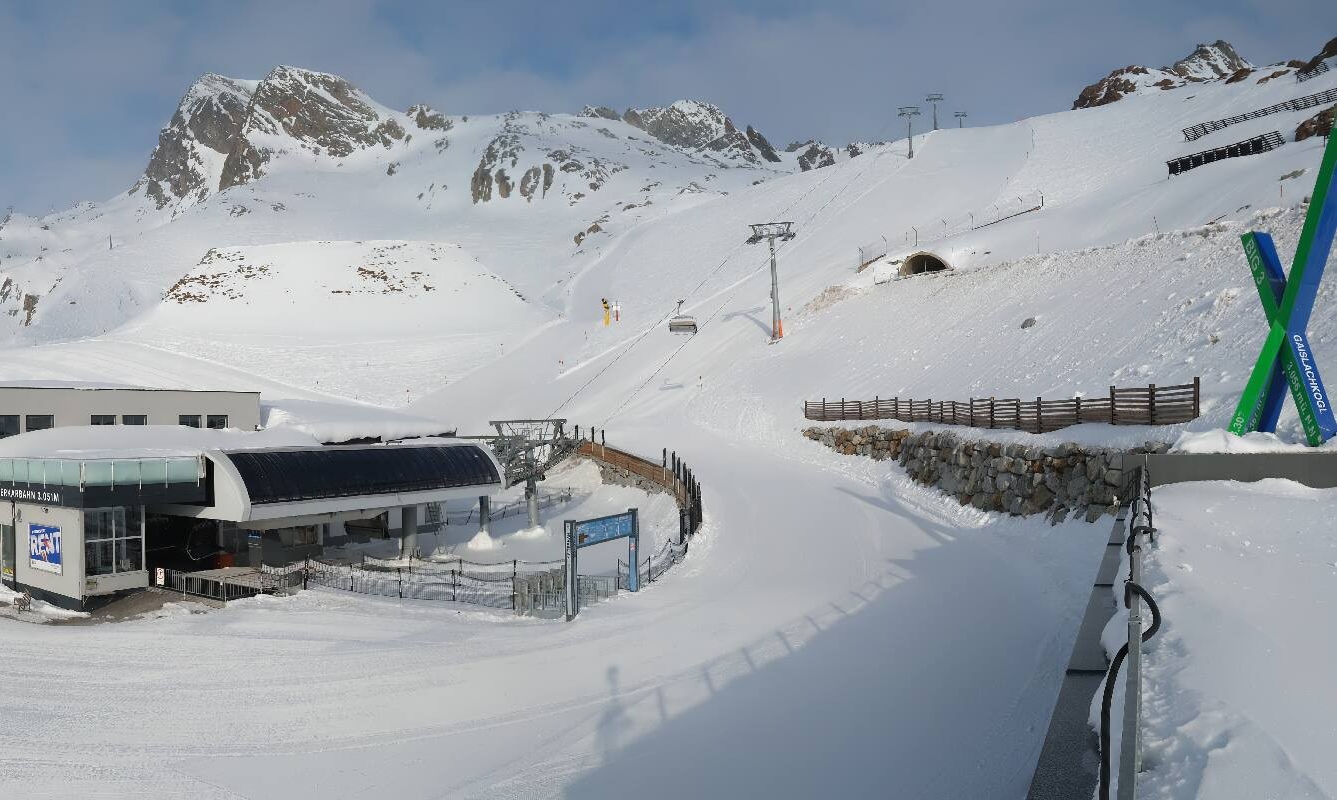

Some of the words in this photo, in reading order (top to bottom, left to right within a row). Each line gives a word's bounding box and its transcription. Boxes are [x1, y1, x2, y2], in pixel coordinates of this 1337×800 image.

[1246, 238, 1260, 271] BIG
[1257, 271, 1265, 285] 3
[1293, 334, 1328, 415] GAISLACHKOGL
